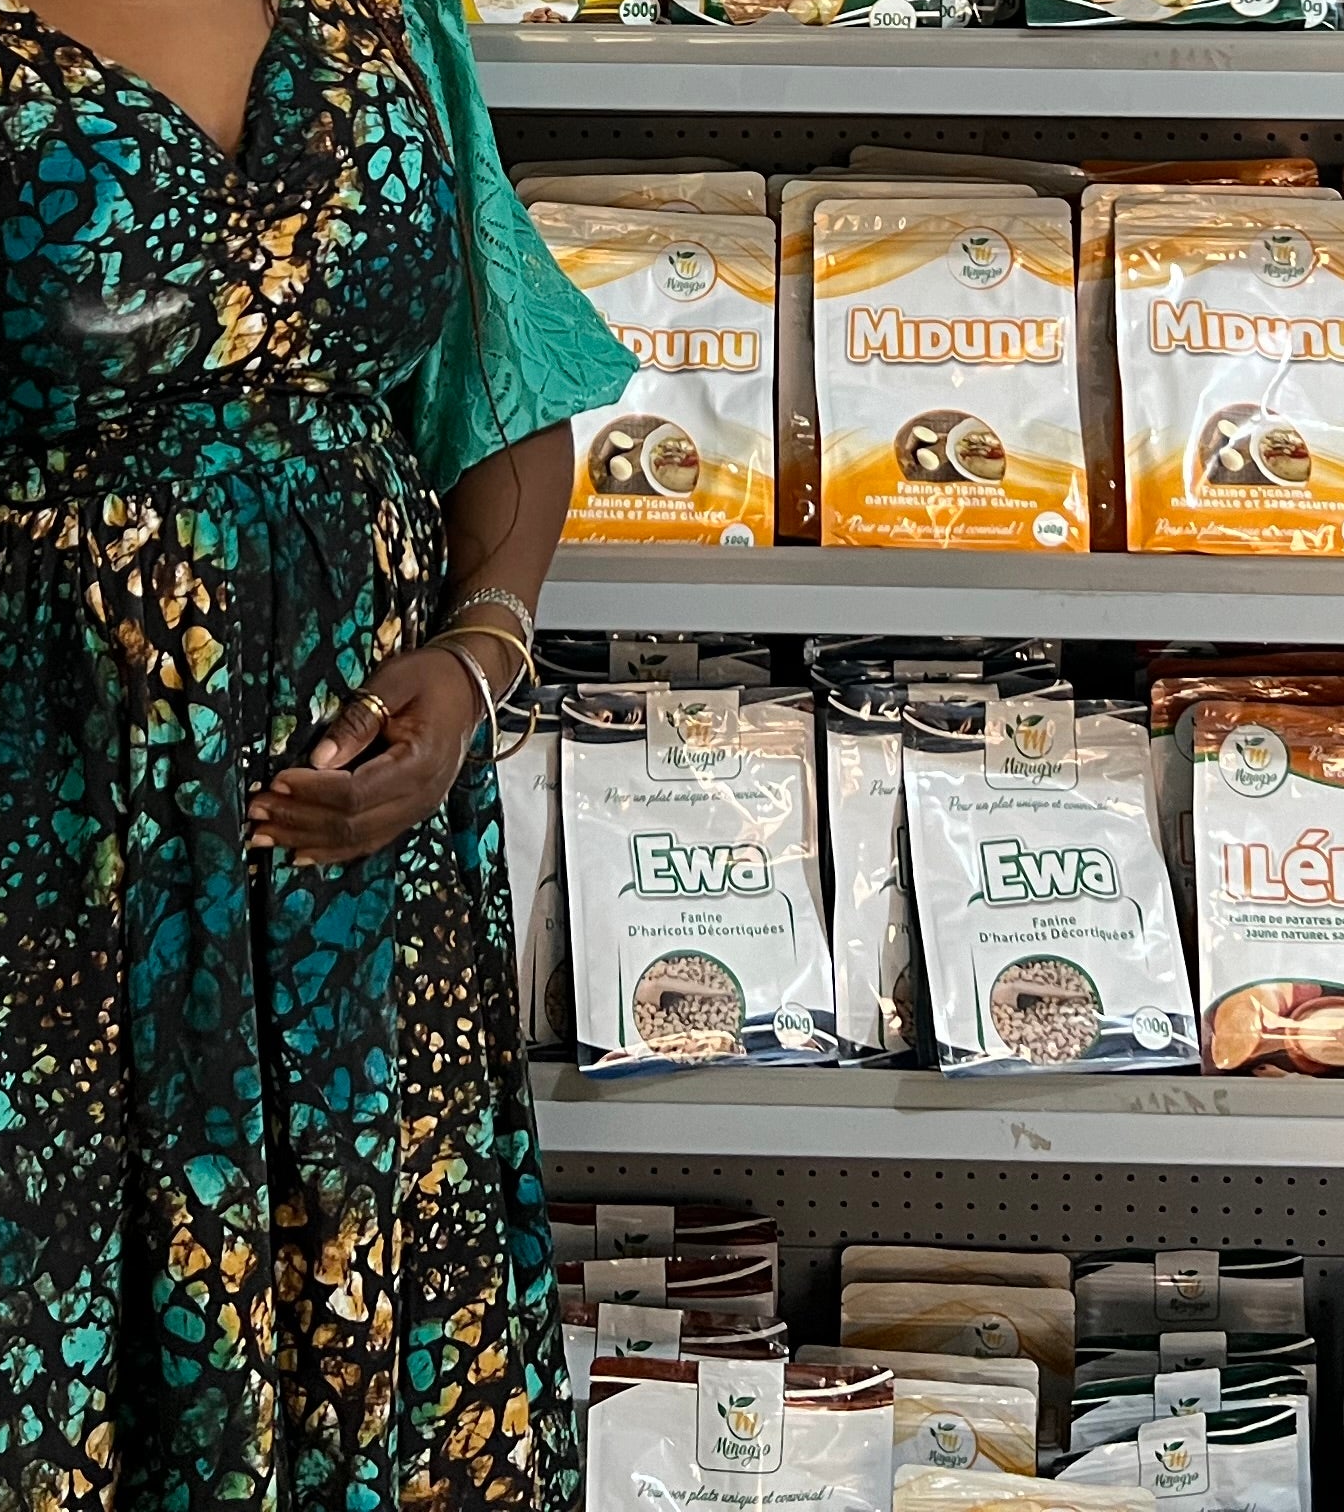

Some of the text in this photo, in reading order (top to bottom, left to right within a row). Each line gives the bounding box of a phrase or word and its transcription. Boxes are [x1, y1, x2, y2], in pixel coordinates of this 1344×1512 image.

[622, 1, 658, 21] 500g
[775, 1013, 812, 1035] 500g
[1134, 1018, 1170, 1037] 500g
[712, 1436, 772, 1468] Minagro
